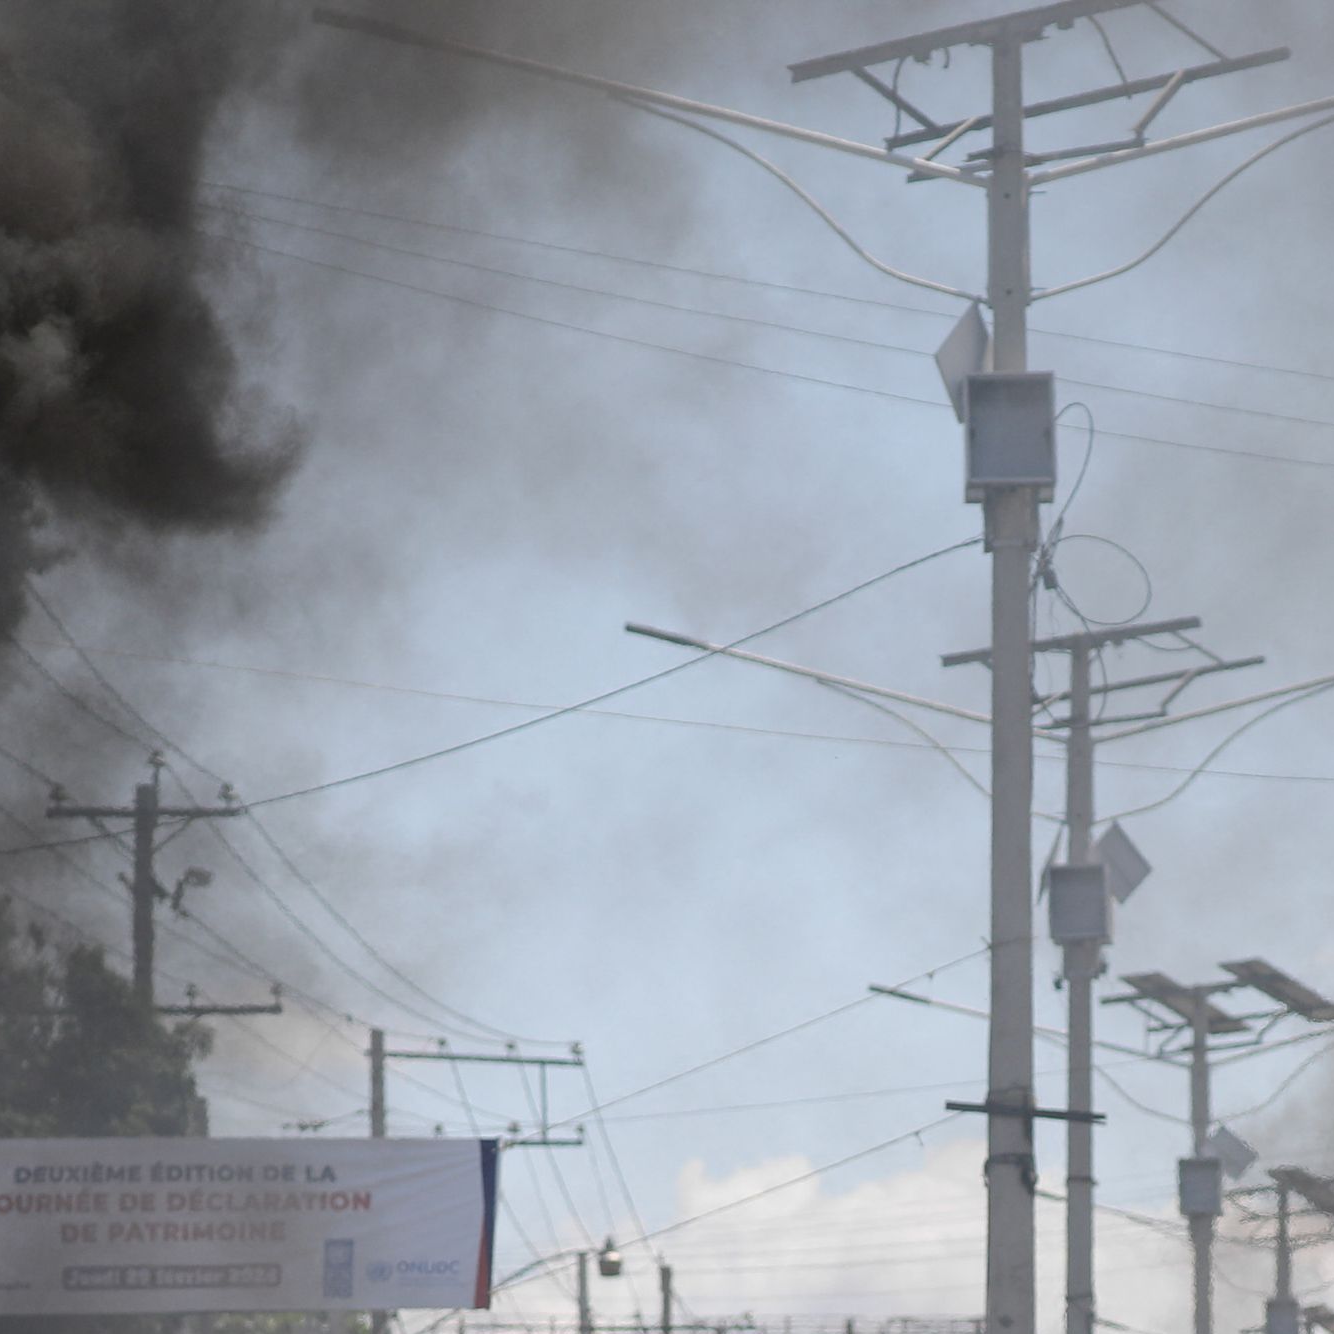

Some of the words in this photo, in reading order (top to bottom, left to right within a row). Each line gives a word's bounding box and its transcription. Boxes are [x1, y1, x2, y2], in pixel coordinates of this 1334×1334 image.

[13, 1161, 142, 1184] DEUXIÈME
[150, 1160, 254, 1183] ÉDITION
[263, 1165, 295, 1183] DE
[305, 1164, 336, 1183] LA
[119, 1192, 156, 1213] DE
[166, 1188, 372, 1213] DÉCLARATION
[60, 1222, 98, 1244] DE
[108, 1221, 287, 1243] PATRIMOINE
